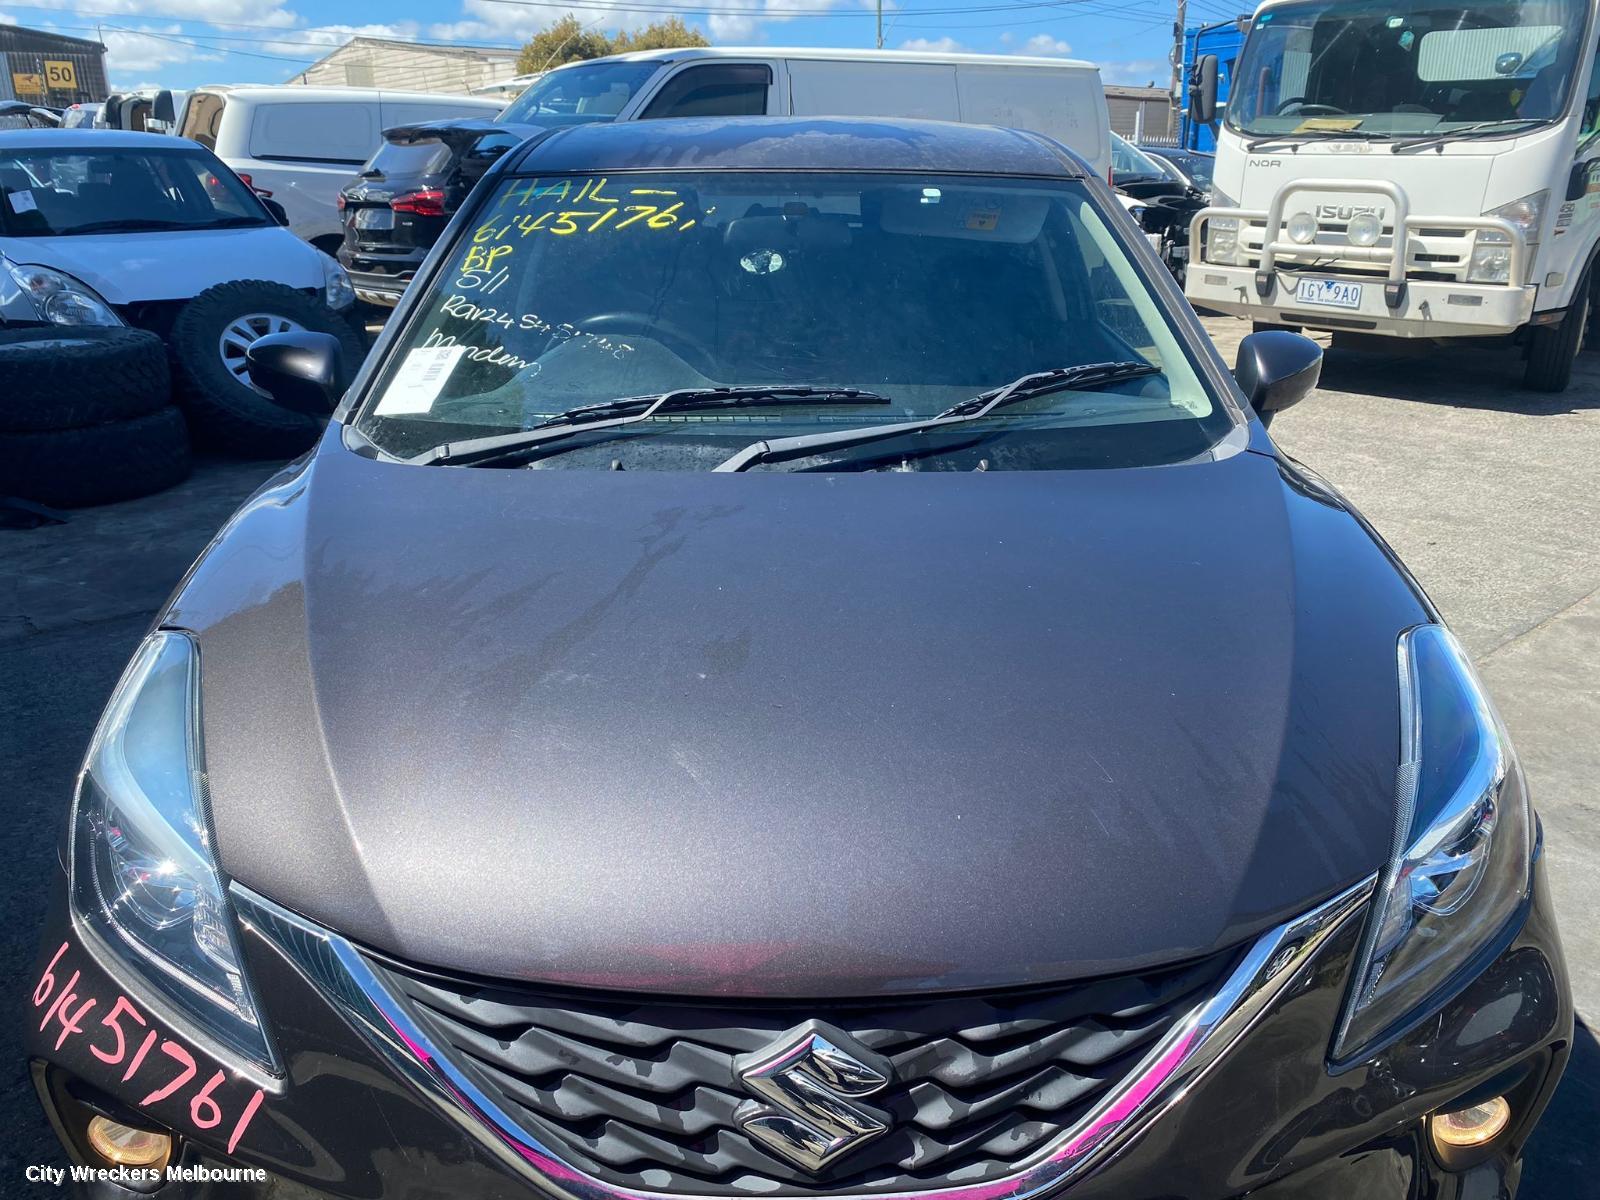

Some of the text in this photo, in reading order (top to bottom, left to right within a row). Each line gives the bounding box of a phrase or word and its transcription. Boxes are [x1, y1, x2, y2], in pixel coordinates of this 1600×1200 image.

[50, 67, 72, 82] 50
[500, 178, 619, 206] HAIL
[460, 245, 513, 272] BP
[32, 942, 265, 1155] 61451761
